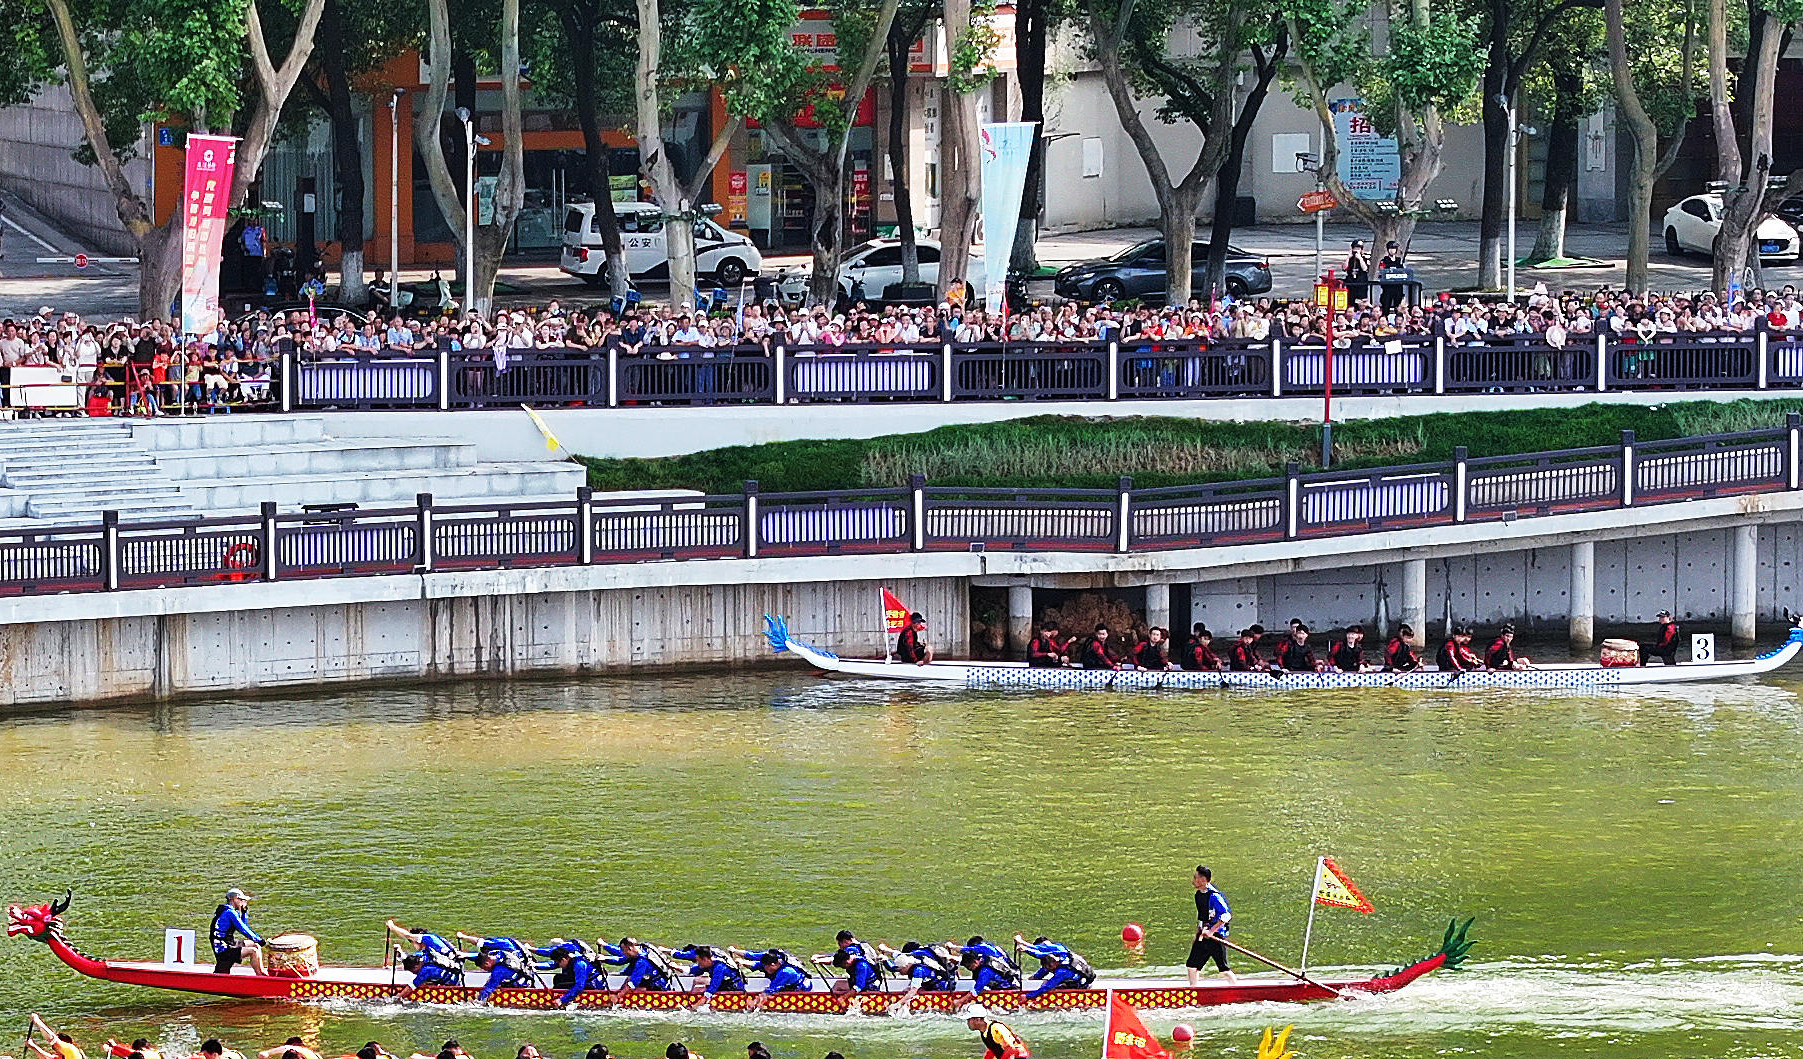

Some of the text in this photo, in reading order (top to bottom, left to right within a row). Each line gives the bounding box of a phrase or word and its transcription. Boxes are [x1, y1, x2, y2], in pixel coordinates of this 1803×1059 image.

[628, 237, 652, 248] 公安
[1696, 637, 1710, 660] 3
[172, 935, 186, 963] 1
